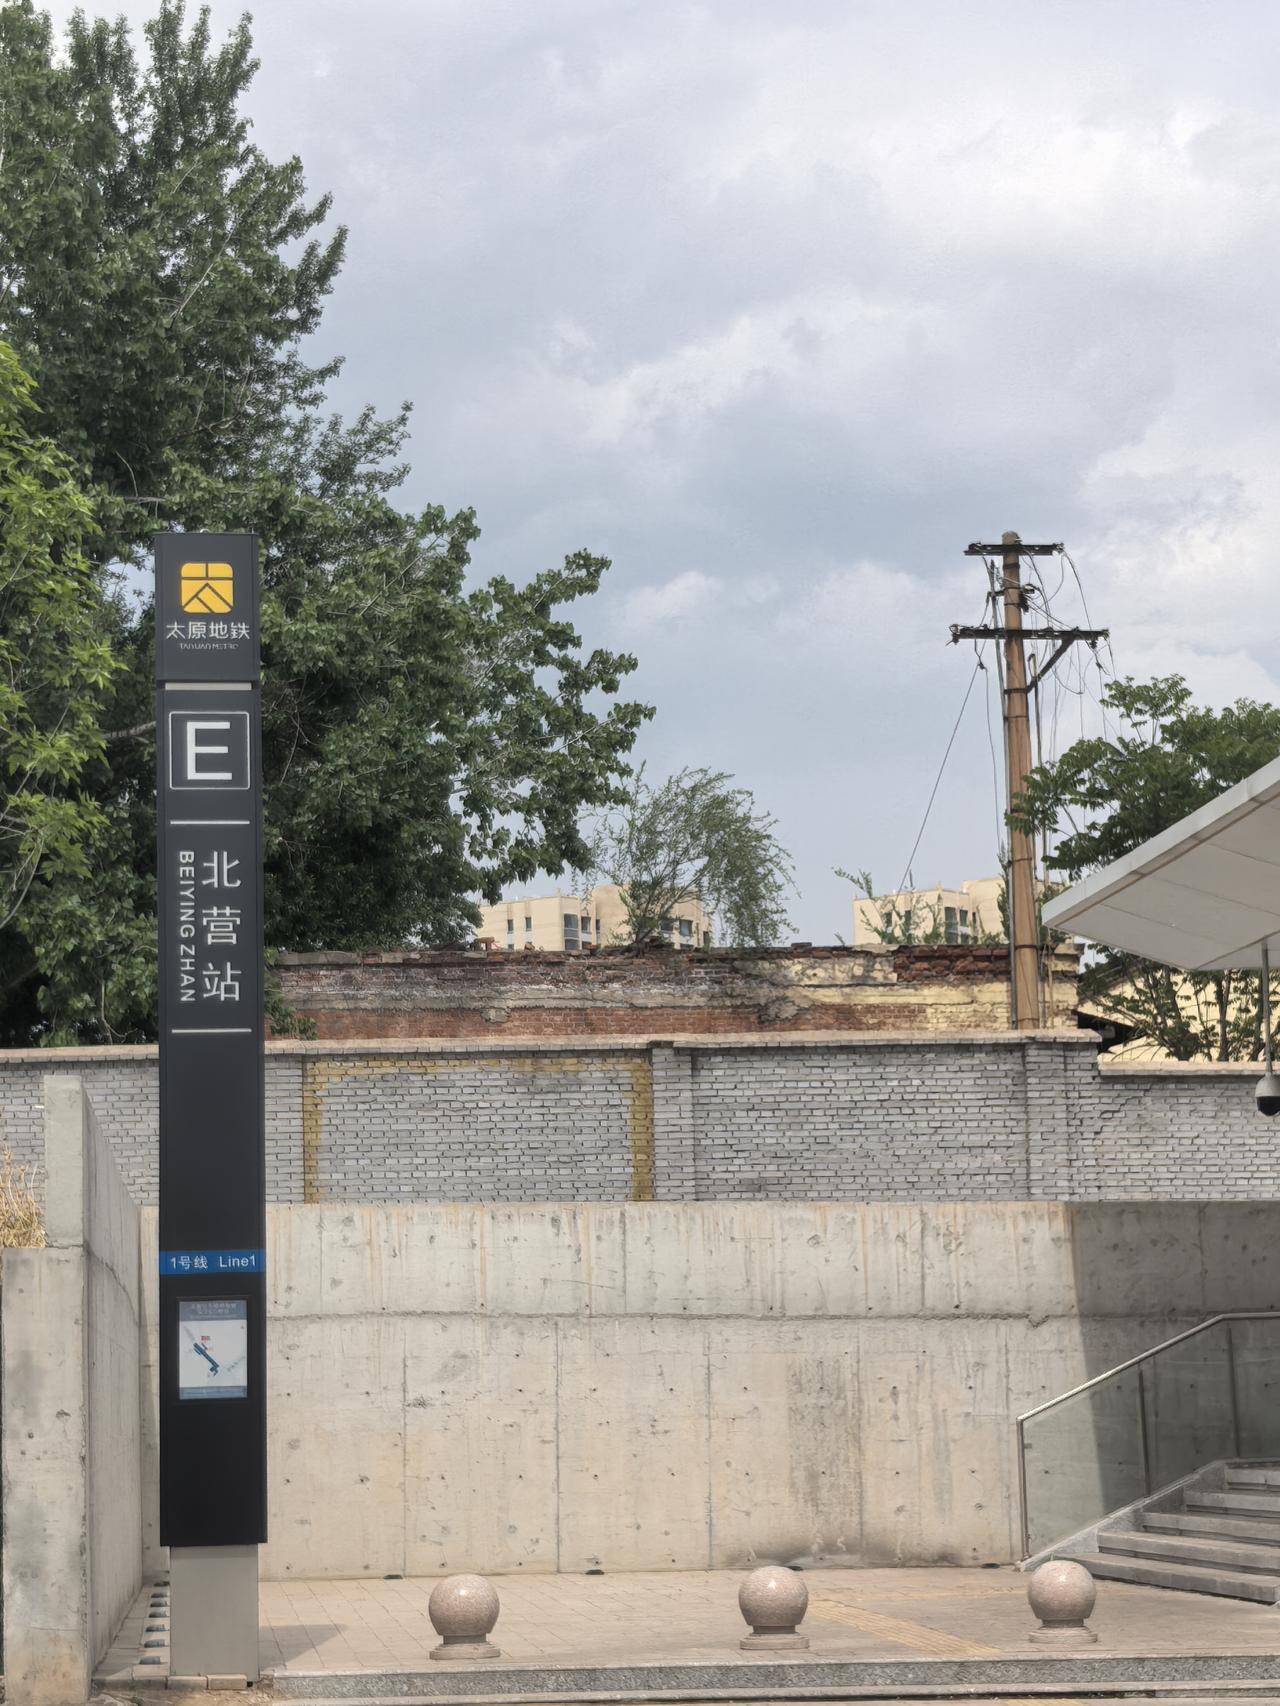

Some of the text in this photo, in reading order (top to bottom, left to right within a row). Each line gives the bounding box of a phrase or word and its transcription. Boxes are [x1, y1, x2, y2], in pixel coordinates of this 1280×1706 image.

[166, 621, 250, 640] 太原地铁
[186, 721, 232, 780] E
[179, 851, 195, 1002] BEIYING ZHAN
[202, 850, 241, 1001] 北营站
[170, 1254, 256, 1270] 1号线 Line1
